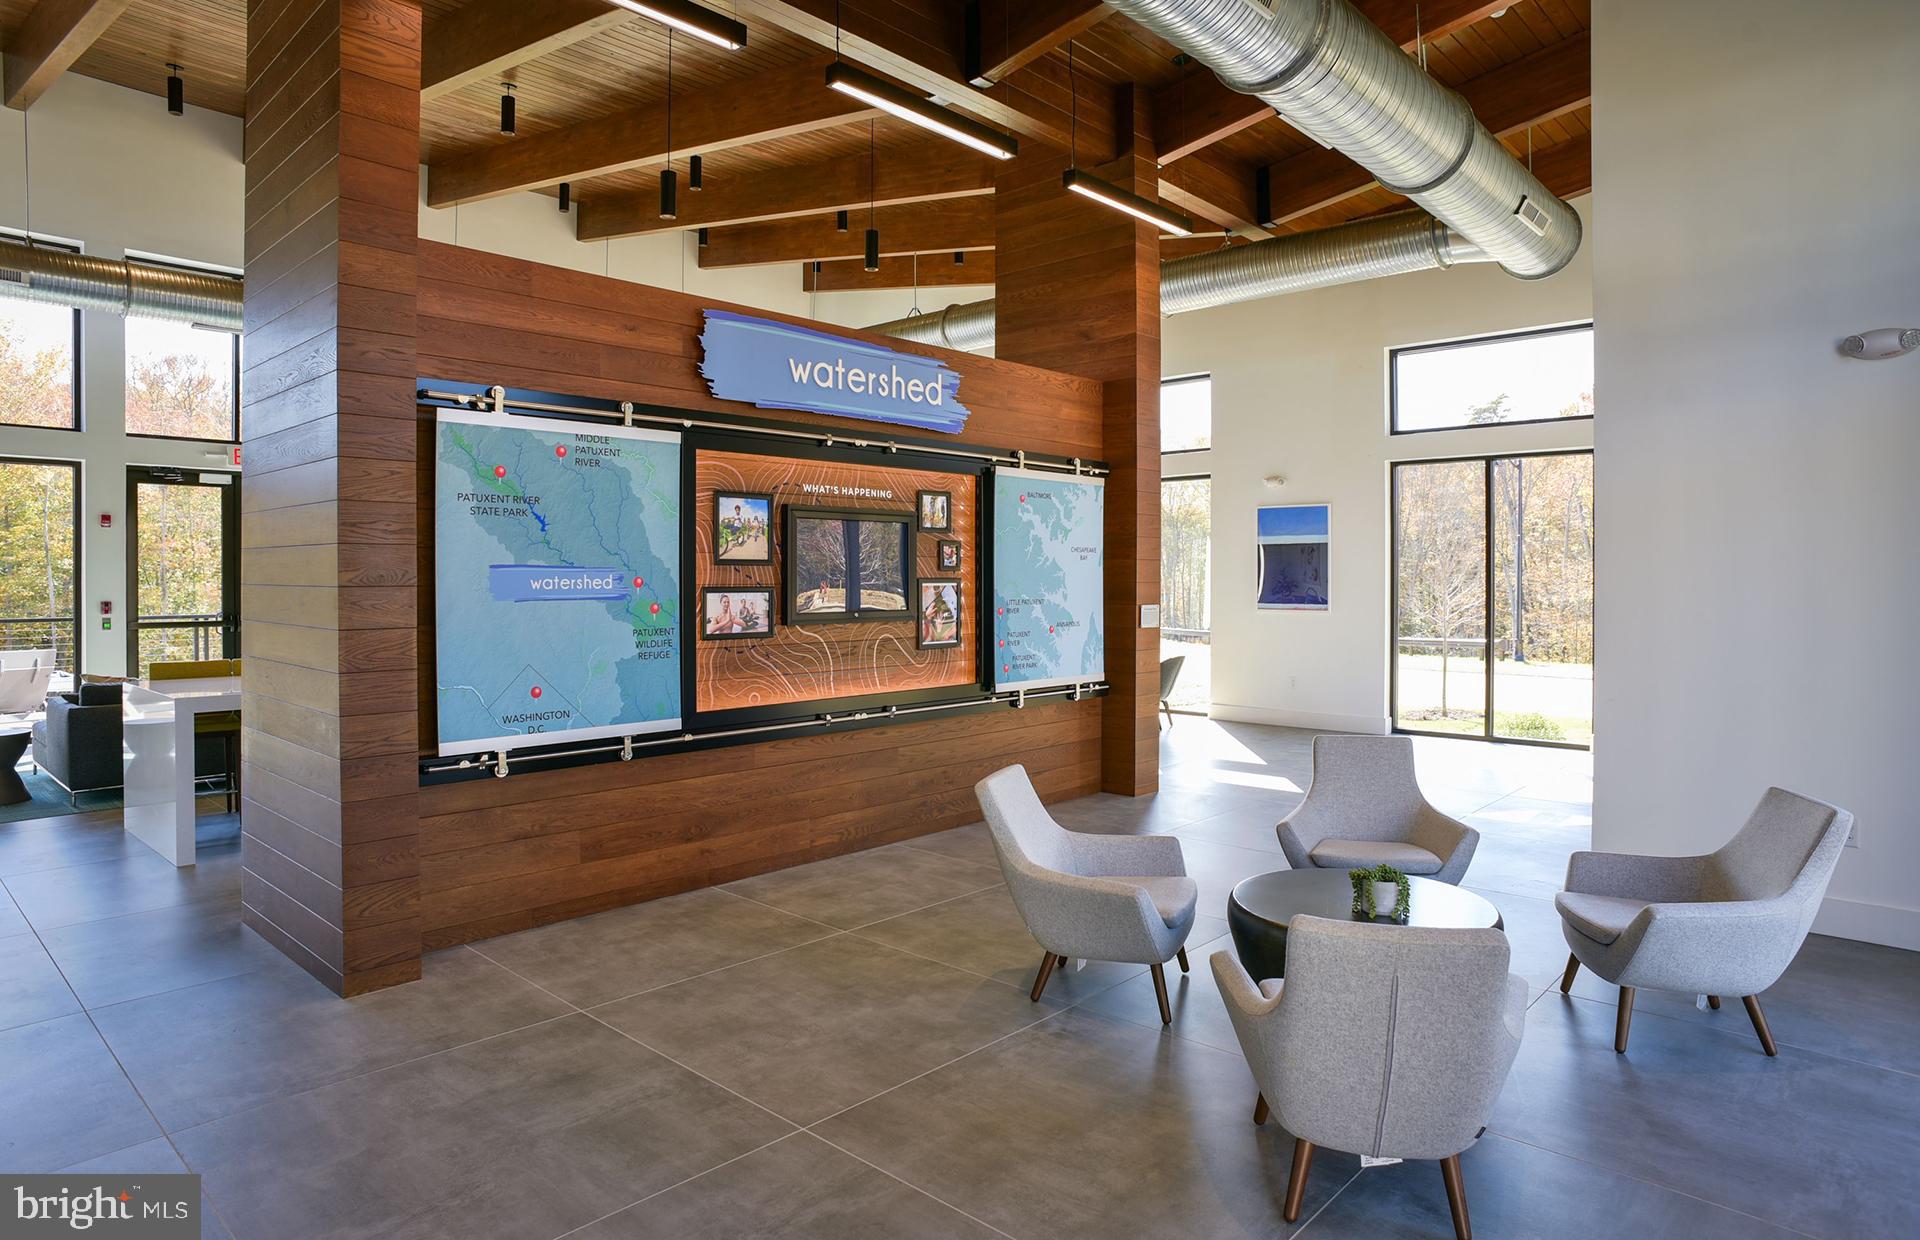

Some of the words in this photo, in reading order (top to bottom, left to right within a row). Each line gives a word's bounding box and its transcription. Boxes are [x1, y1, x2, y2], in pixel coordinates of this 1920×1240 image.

[788, 357, 943, 406] watershed
[575, 434, 610, 445] MIDDLE
[575, 445, 621, 457] PATUXENT
[575, 457, 601, 467] RIVER
[802, 483, 839, 494] WHAT'S
[841, 486, 893, 499] HAPPENING
[457, 492, 511, 504] PATUXENT
[512, 495, 541, 505] RIVER
[470, 506, 501, 516] STATE
[503, 507, 528, 517] PARK
[530, 573, 613, 591] watershed
[632, 627, 675, 637] PATUXENT
[635, 639, 673, 648] WILDLIFE
[638, 650, 671, 660] REFUGE
[502, 710, 570, 724] WASHINGTON
